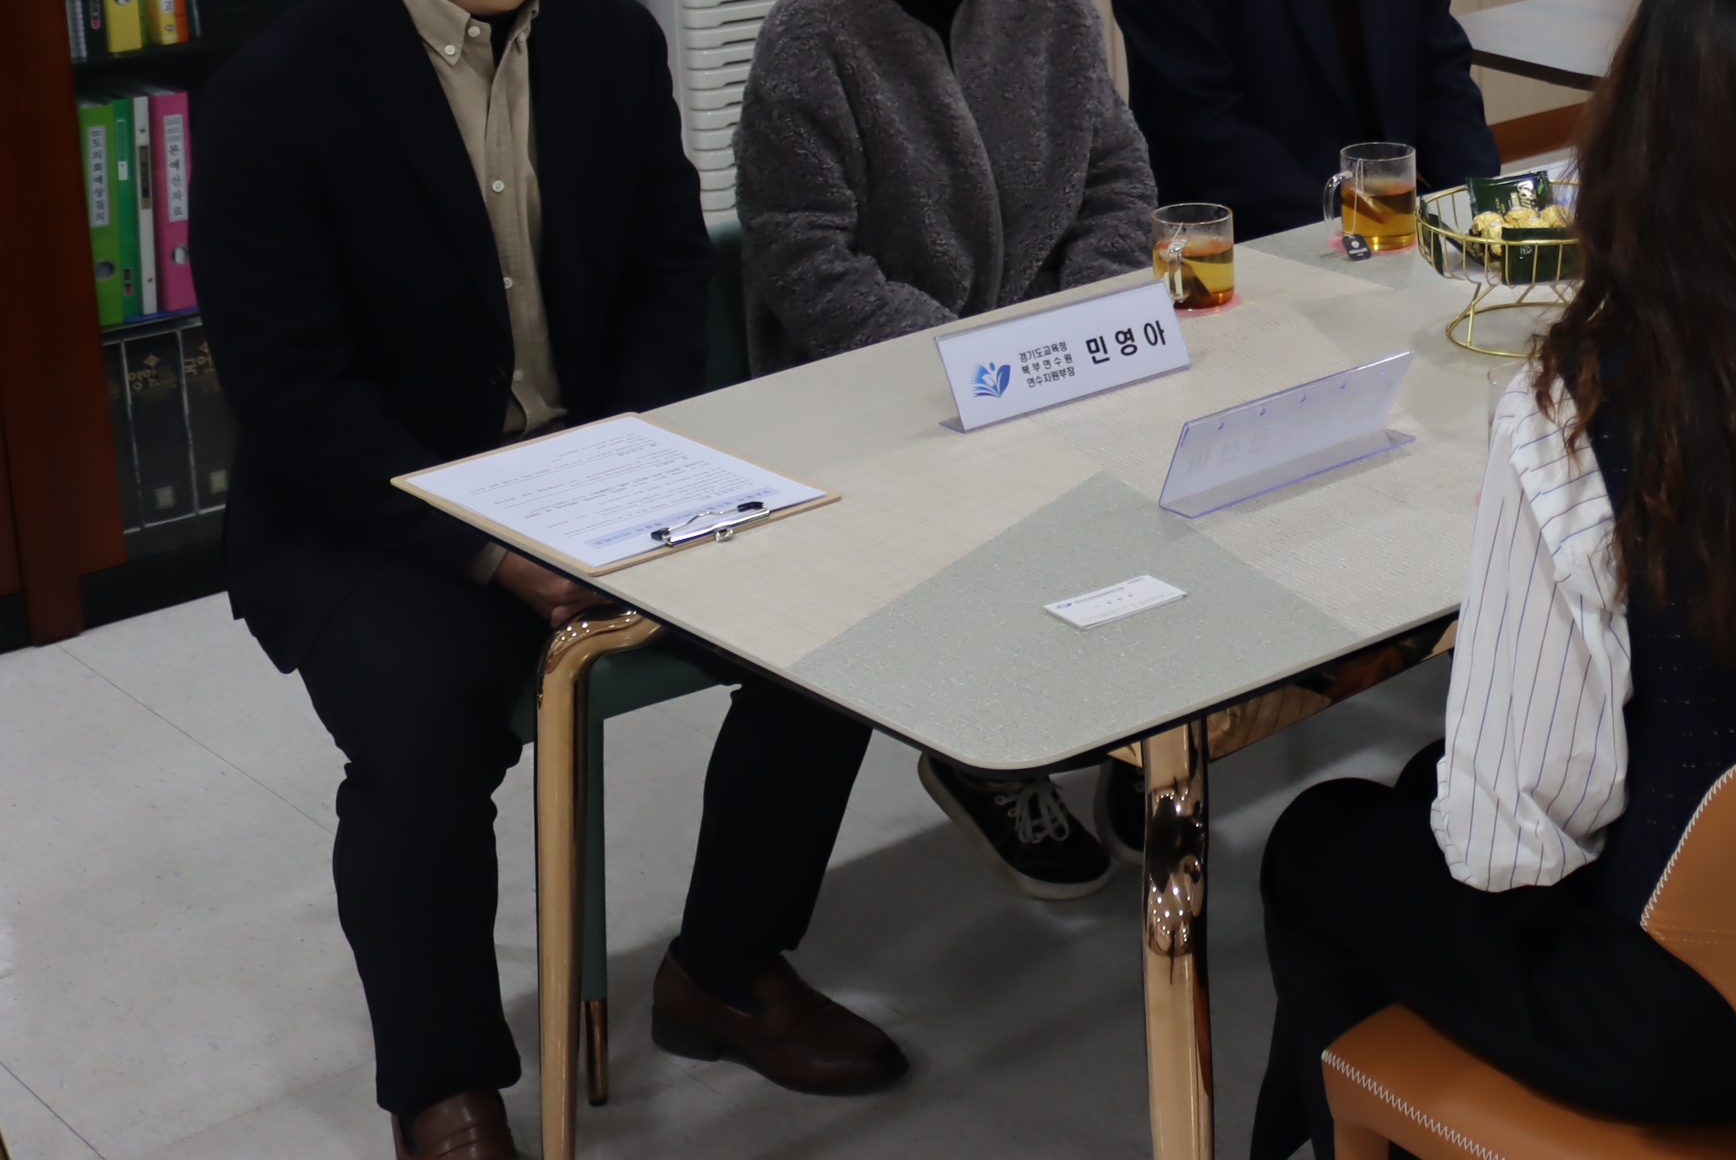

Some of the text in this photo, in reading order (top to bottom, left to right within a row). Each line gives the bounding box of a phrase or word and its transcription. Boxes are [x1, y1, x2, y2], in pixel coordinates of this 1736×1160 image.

[1018, 340, 1068, 363] 경기도교육청
[1085, 320, 1166, 365] 민영아
[1026, 366, 1076, 389] 연수지원부장
